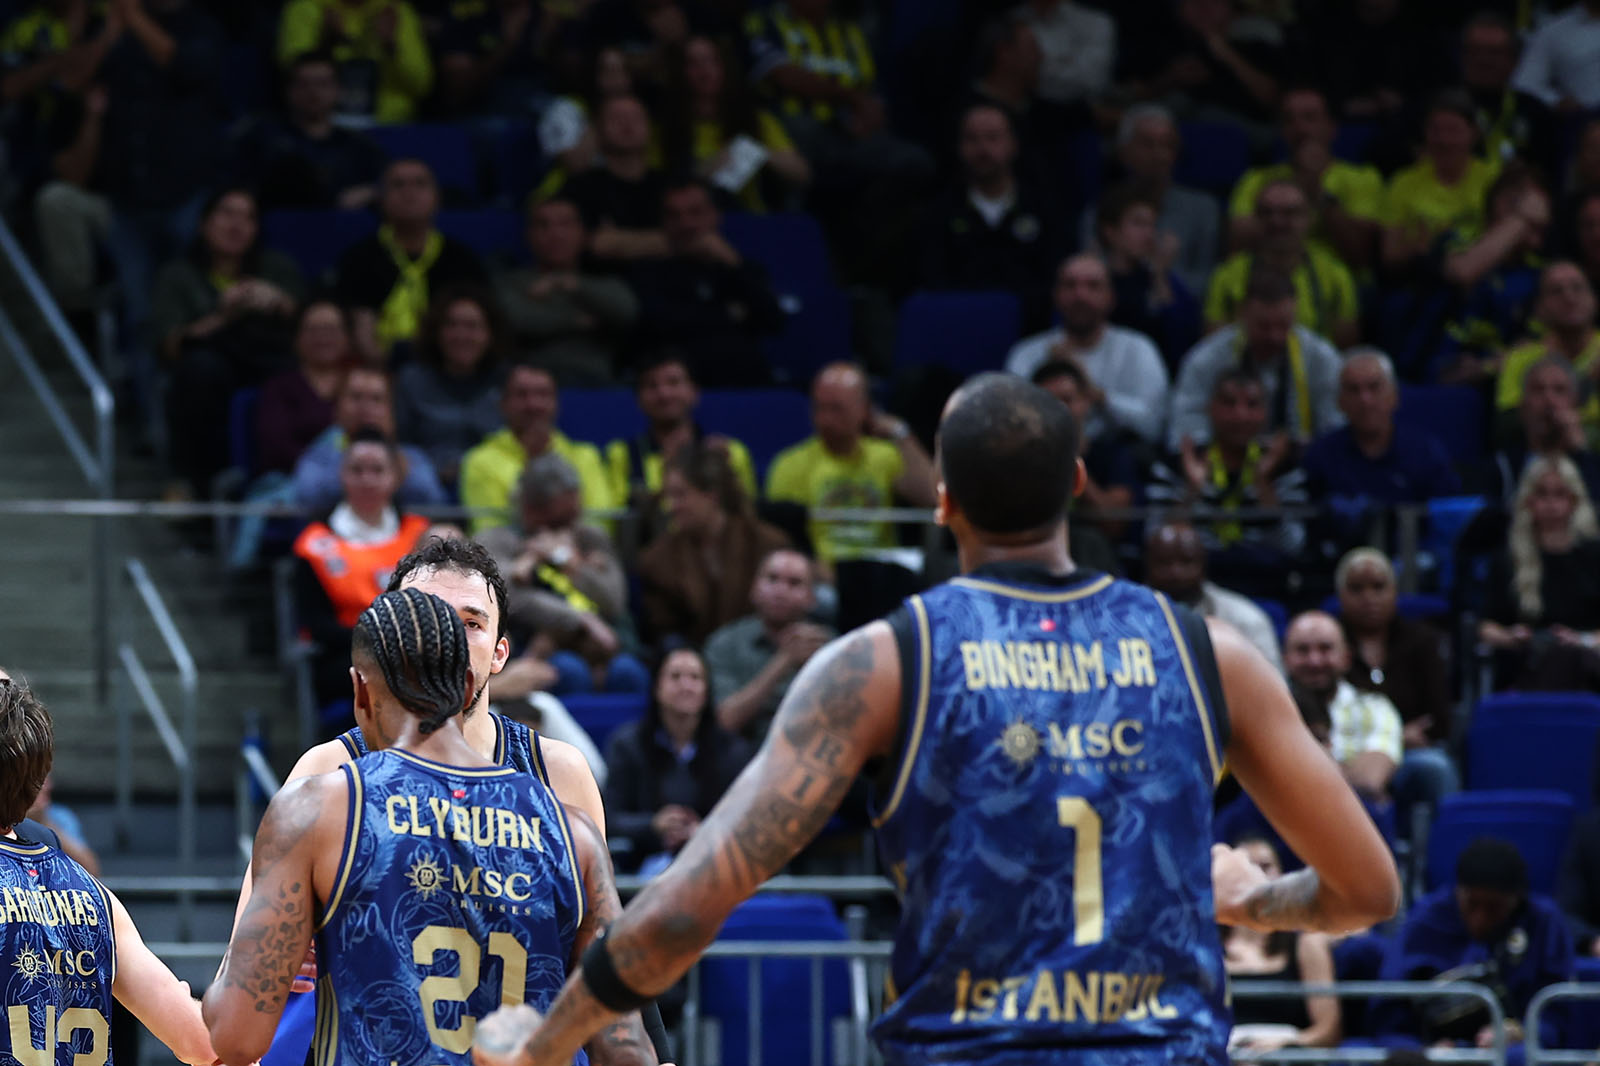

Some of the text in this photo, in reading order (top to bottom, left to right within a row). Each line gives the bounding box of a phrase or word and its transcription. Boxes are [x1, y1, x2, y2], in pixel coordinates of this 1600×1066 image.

[960, 637, 1157, 693] BINGHAM JR
[1047, 719, 1144, 760] MSC
[385, 795, 544, 852] CLYBURN
[451, 864, 532, 901] MSC
[1056, 796, 1104, 946] 1
[43, 949, 96, 976] MSC
[412, 925, 527, 1054] 21
